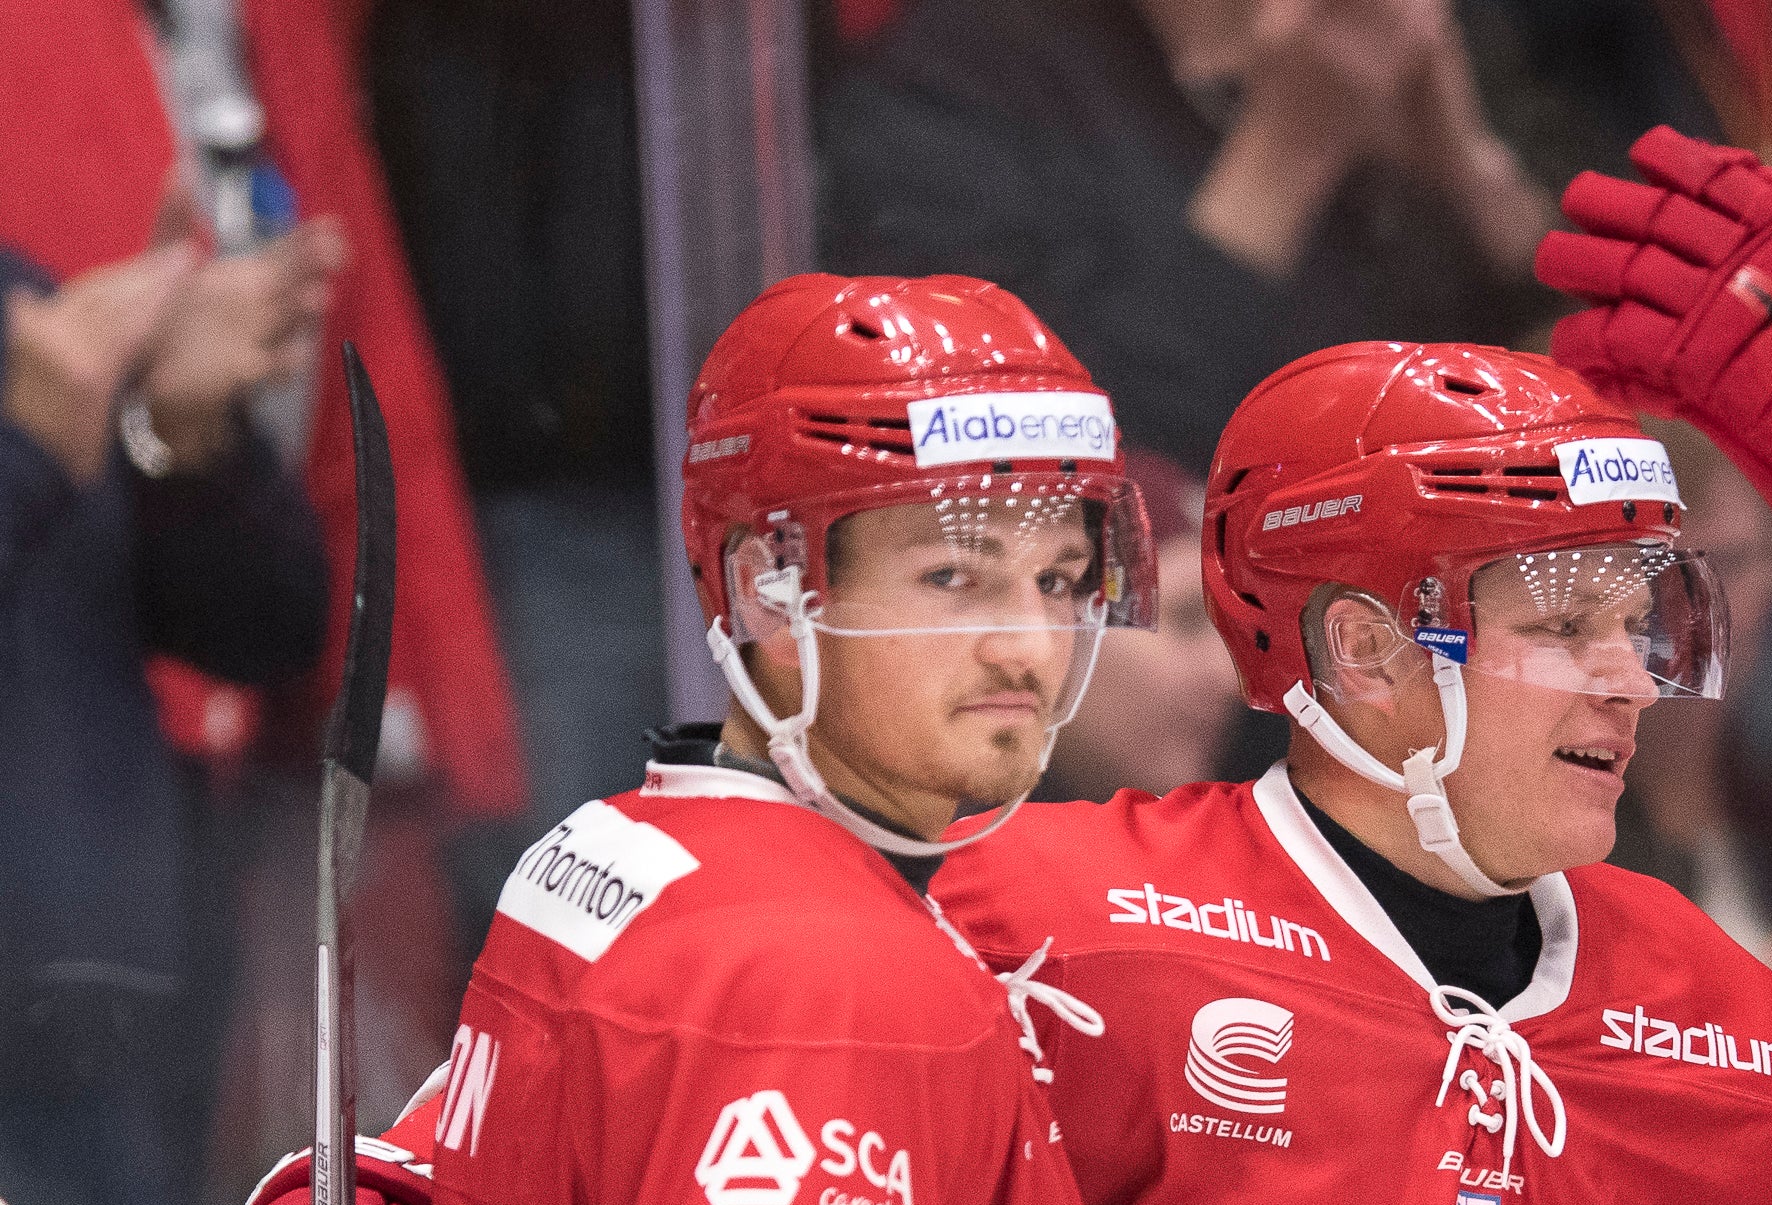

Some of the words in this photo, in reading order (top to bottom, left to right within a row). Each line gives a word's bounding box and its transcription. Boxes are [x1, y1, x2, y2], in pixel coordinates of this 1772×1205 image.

[919, 403, 1112, 451] Aiabenergy
[1570, 446, 1674, 487] Aiabene
[1262, 494, 1363, 532] BAUER
[1417, 631, 1466, 645] BAUER
[518, 824, 650, 928] Thornton
[1107, 882, 1331, 962] stadium
[1169, 1112, 1293, 1150] CASTELLUM
[1436, 1150, 1525, 1195] BUER
